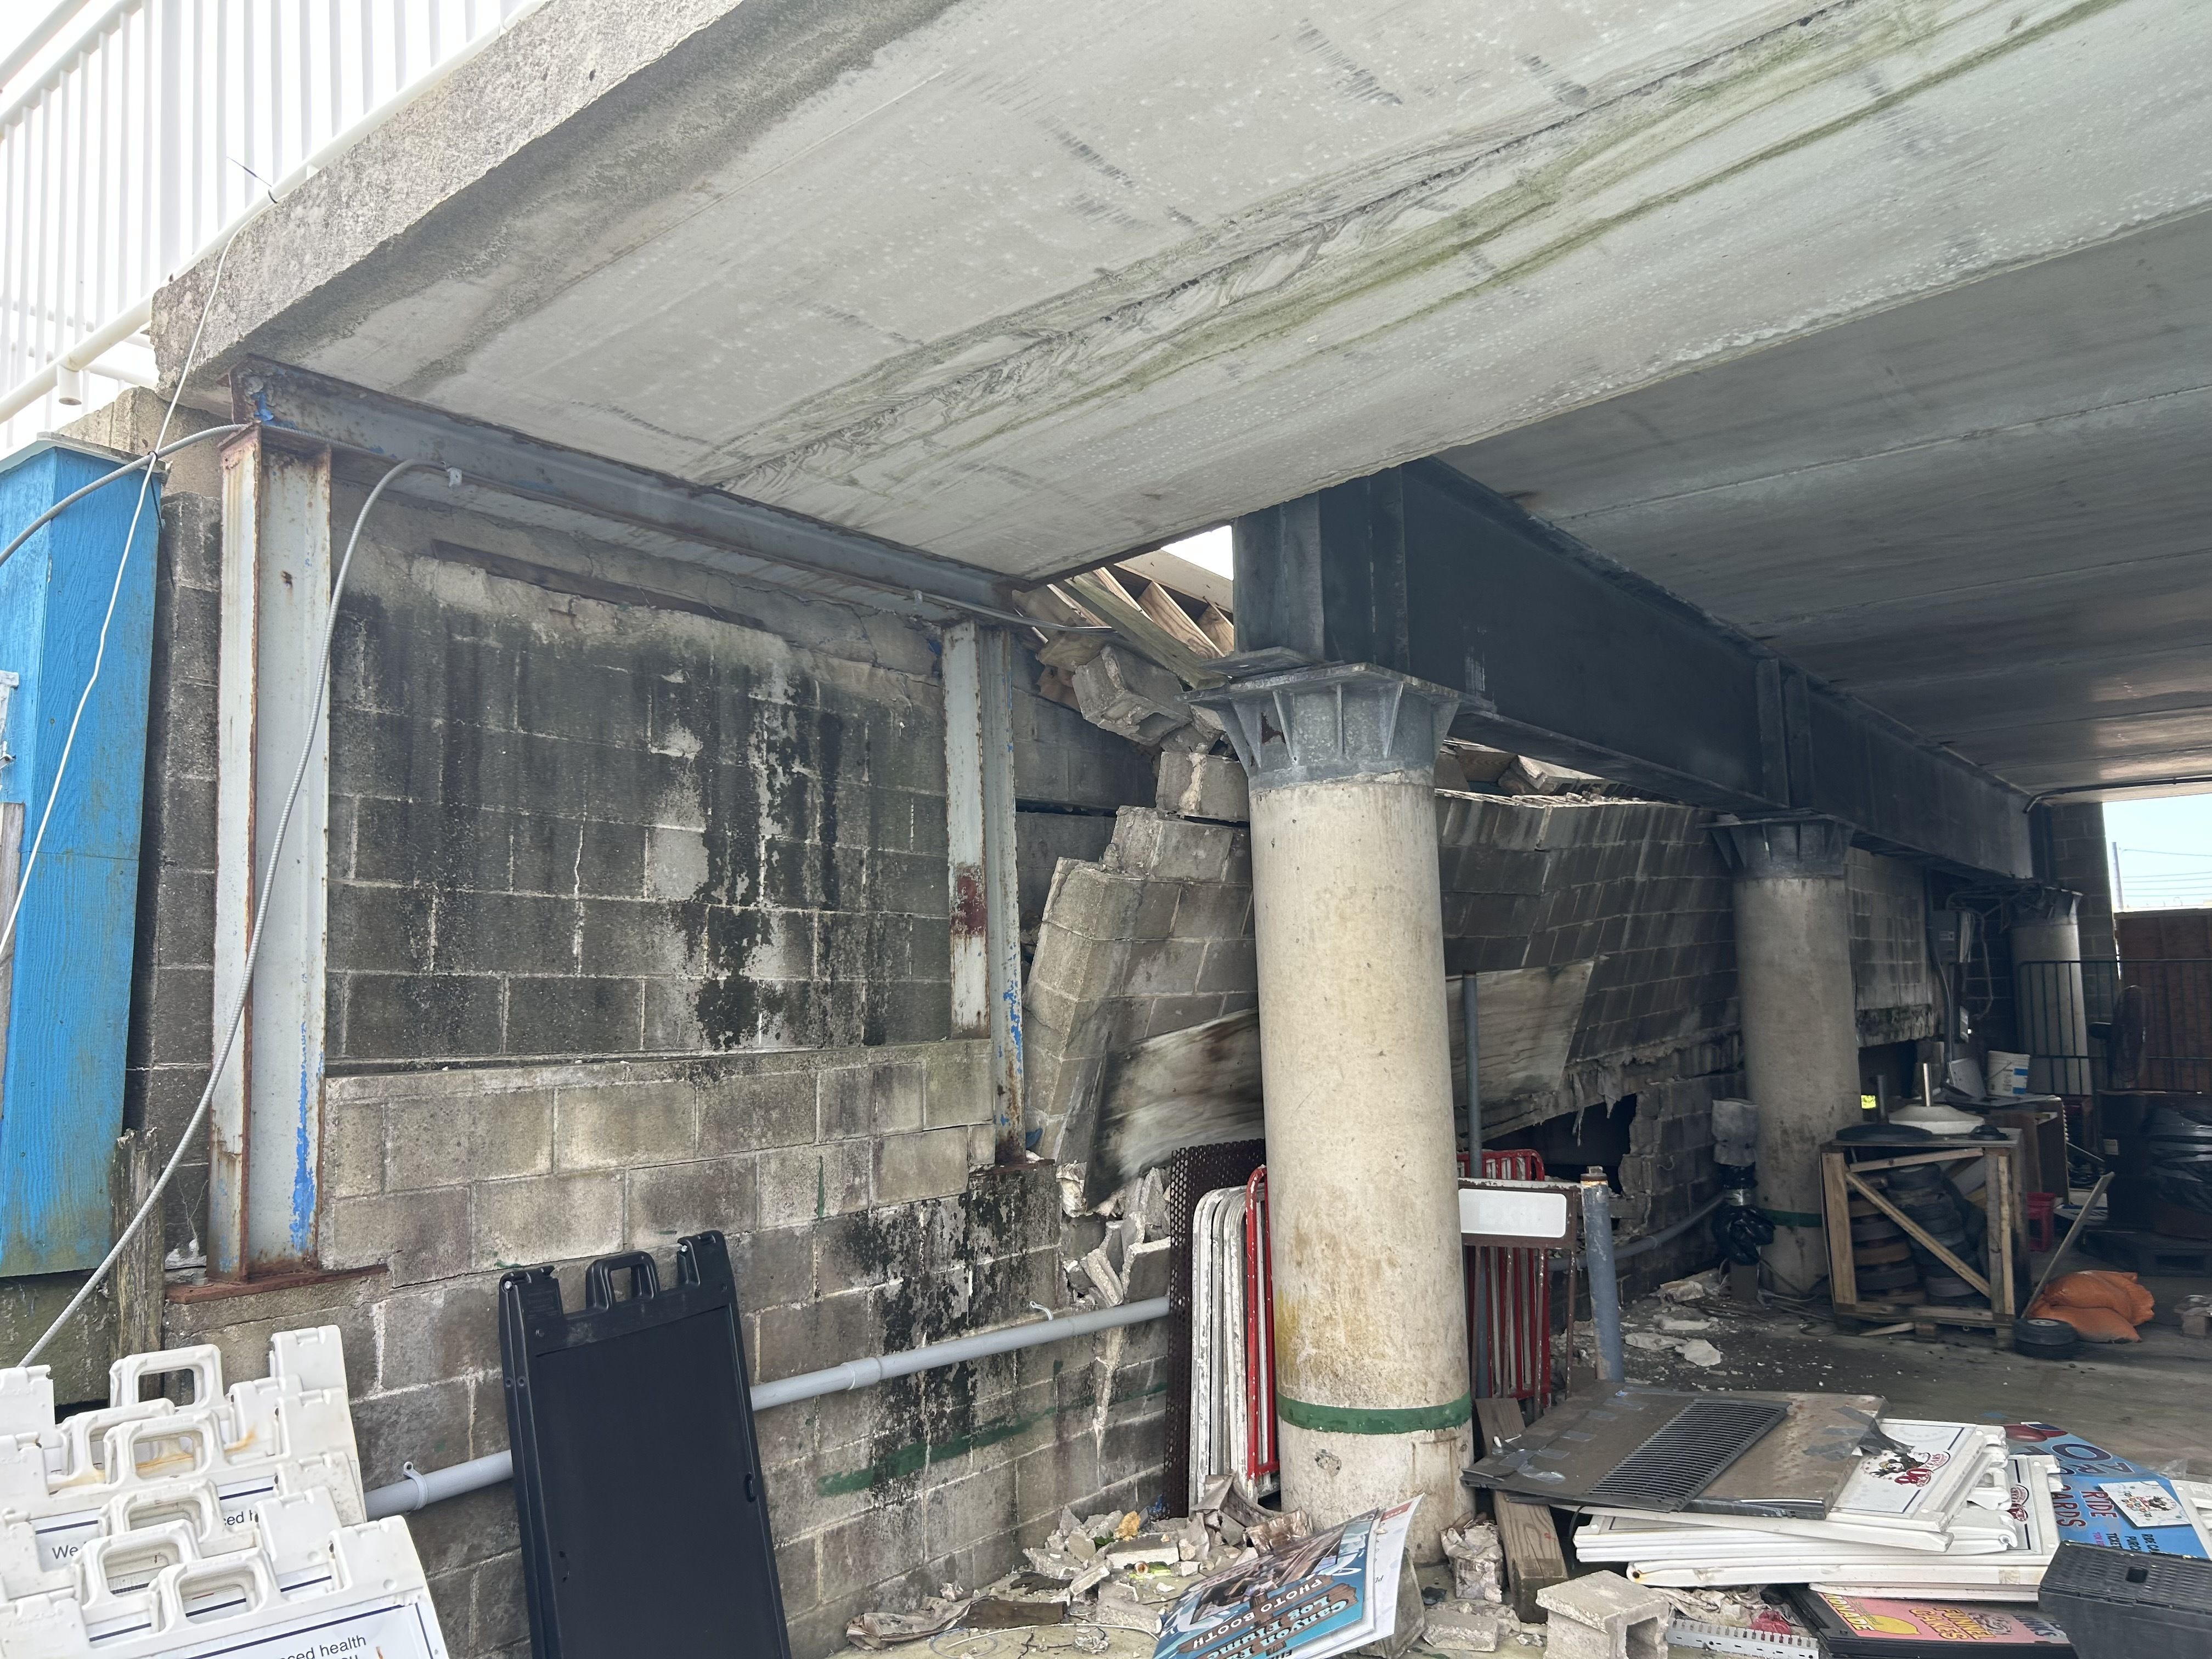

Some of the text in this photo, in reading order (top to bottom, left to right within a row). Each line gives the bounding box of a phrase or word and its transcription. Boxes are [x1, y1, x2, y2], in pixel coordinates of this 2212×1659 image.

[2080, 1491, 2118, 1519] RIDE
[52, 1544, 78, 1560] We
[1193, 1578, 1324, 1649] PHOTO BOOTH
[1207, 1595, 1331, 1658] Log Flume
[1260, 1599, 1350, 1647] Canyon
[1909, 1609, 1969, 1640] CAKES
[1933, 1608, 1996, 1640] FUNNEL
[320, 1635, 366, 1657] health
